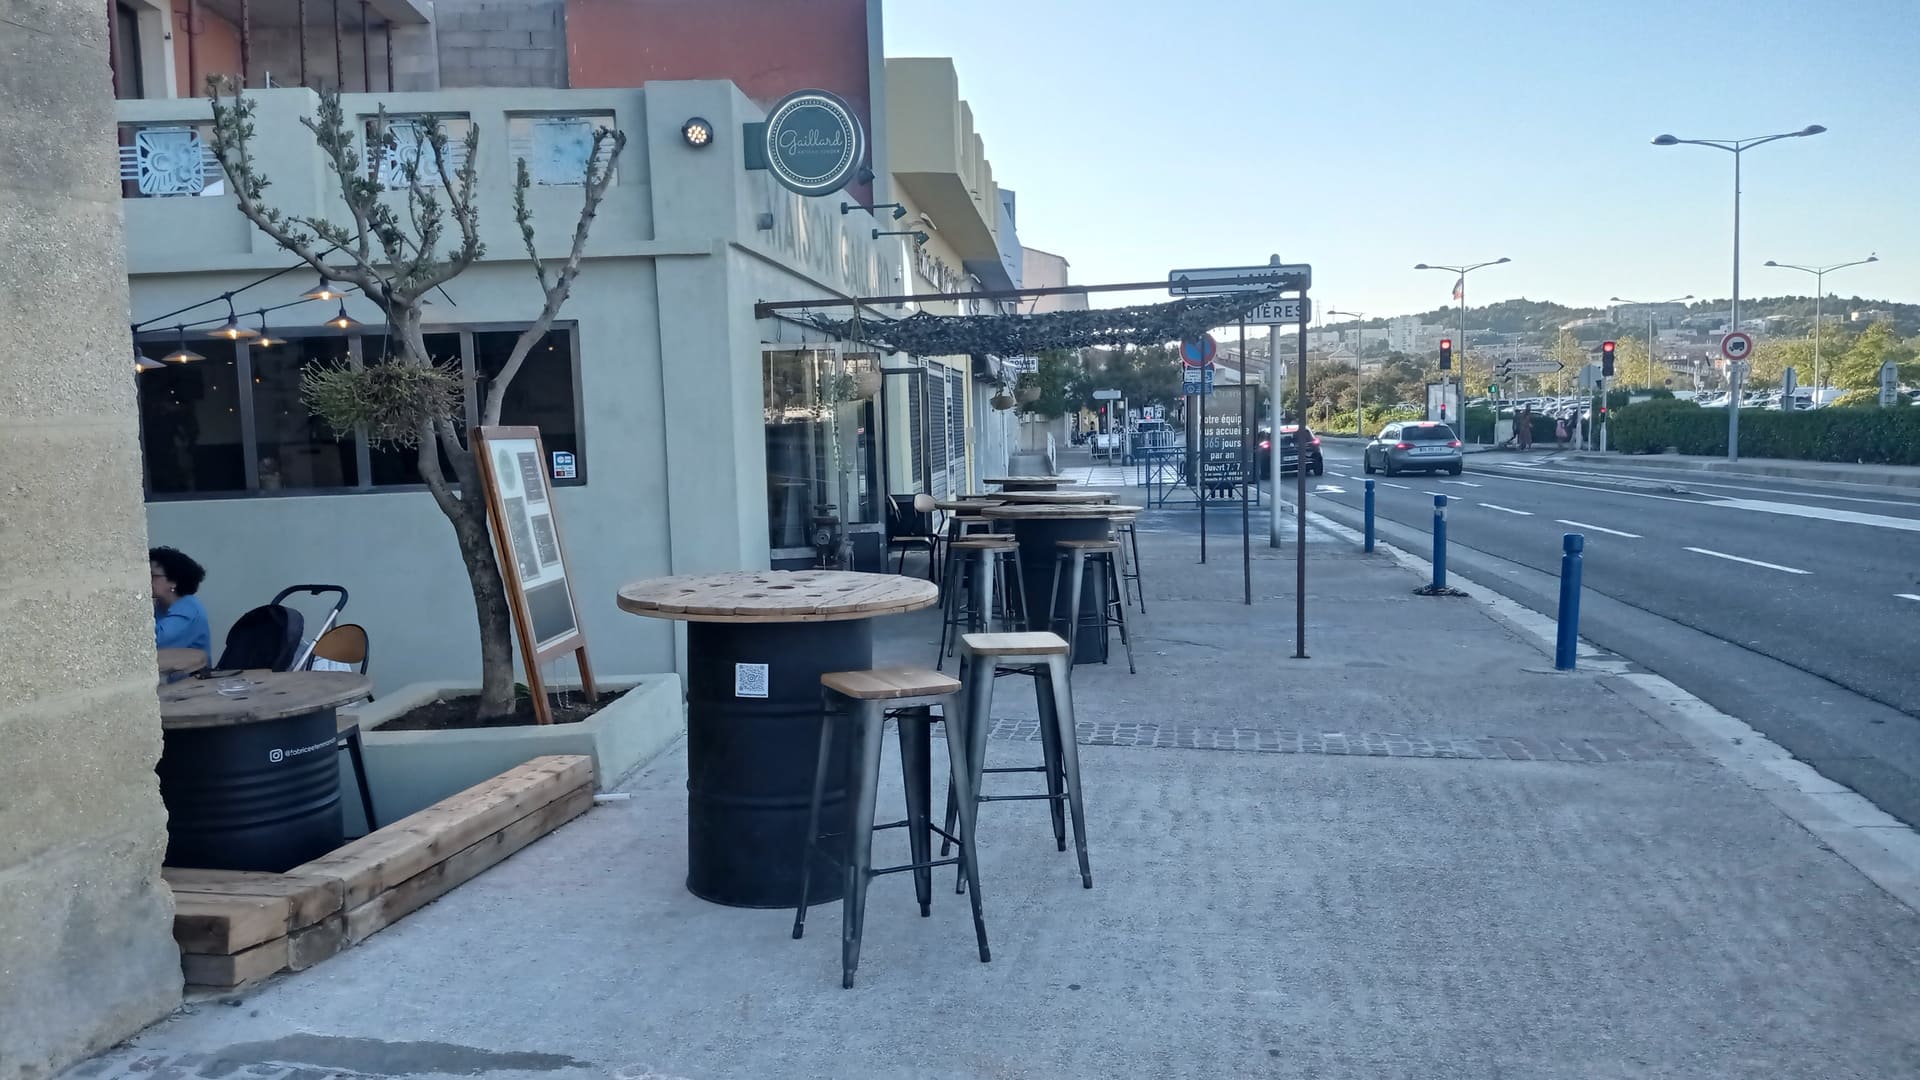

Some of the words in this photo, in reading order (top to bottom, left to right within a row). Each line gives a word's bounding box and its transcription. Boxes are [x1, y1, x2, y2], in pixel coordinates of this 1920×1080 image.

[780, 129, 843, 155] Gaillard
[1246, 303, 1301, 319] UIÈRES
[1201, 415, 1219, 424] otre
[1221, 413, 1242, 425] équip
[1215, 426, 1250, 436] accueie
[1222, 438, 1242, 450] jours
[1210, 452, 1223, 461] par
